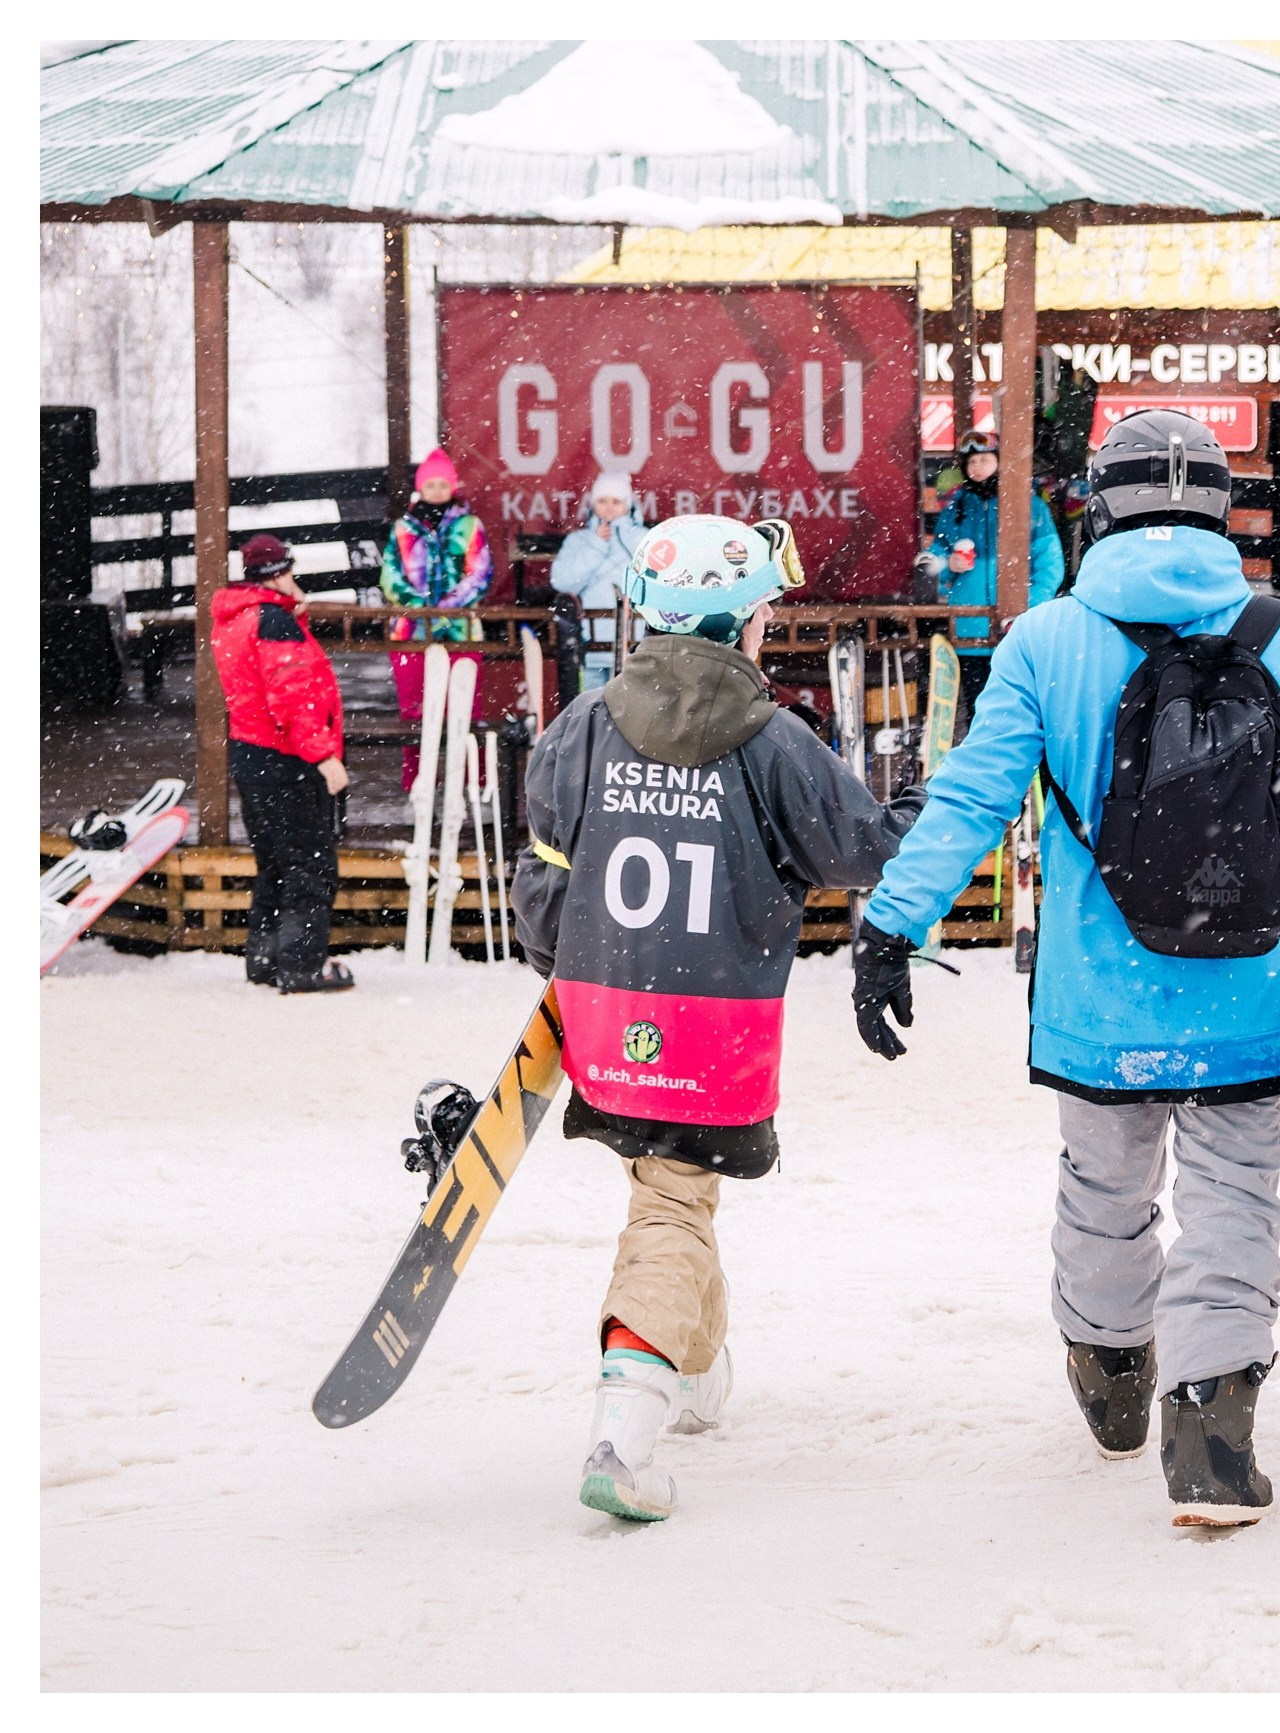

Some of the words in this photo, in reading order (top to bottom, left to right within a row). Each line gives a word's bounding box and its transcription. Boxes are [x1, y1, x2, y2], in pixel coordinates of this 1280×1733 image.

[674, 489, 699, 517] В
[712, 488, 860, 519] ГУБАХЕ
[604, 761, 725, 796] KSENIA
[602, 789, 723, 822] SAKURA
[604, 836, 715, 934] 01
[1185, 884, 1241, 907] Kappa
[587, 1064, 707, 1092] @_rich_sakura_
